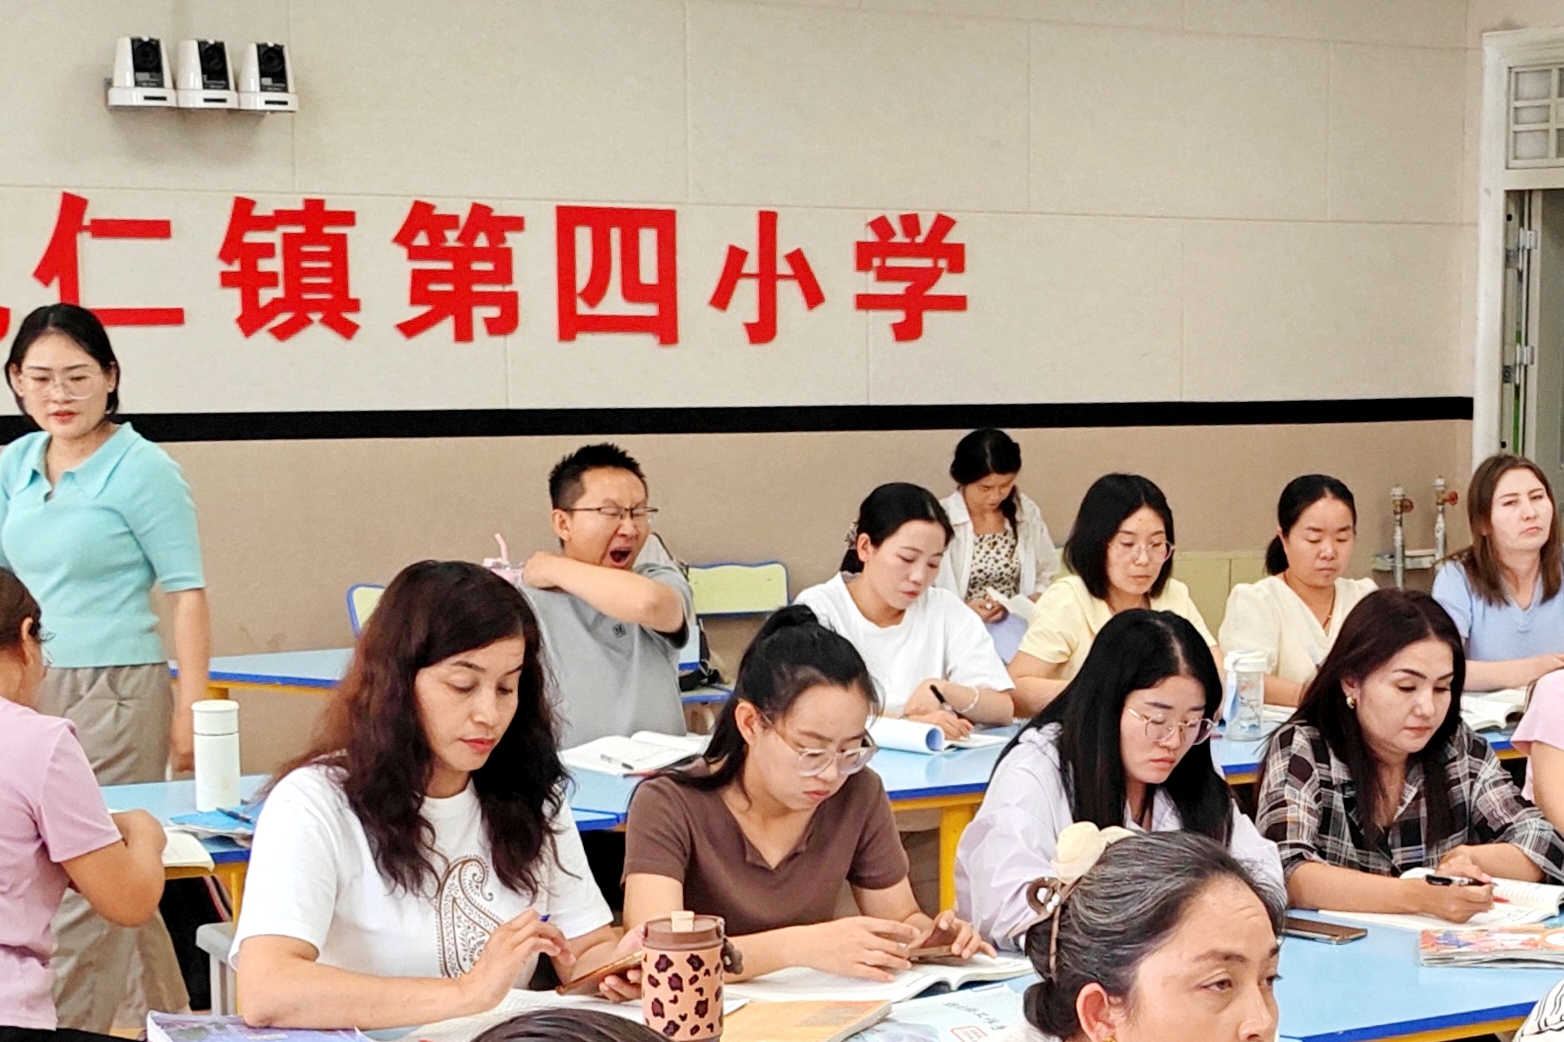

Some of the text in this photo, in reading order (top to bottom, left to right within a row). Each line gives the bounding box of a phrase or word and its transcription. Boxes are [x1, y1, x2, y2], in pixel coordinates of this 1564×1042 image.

[0, 191, 968, 345] 仁镇第四小学
